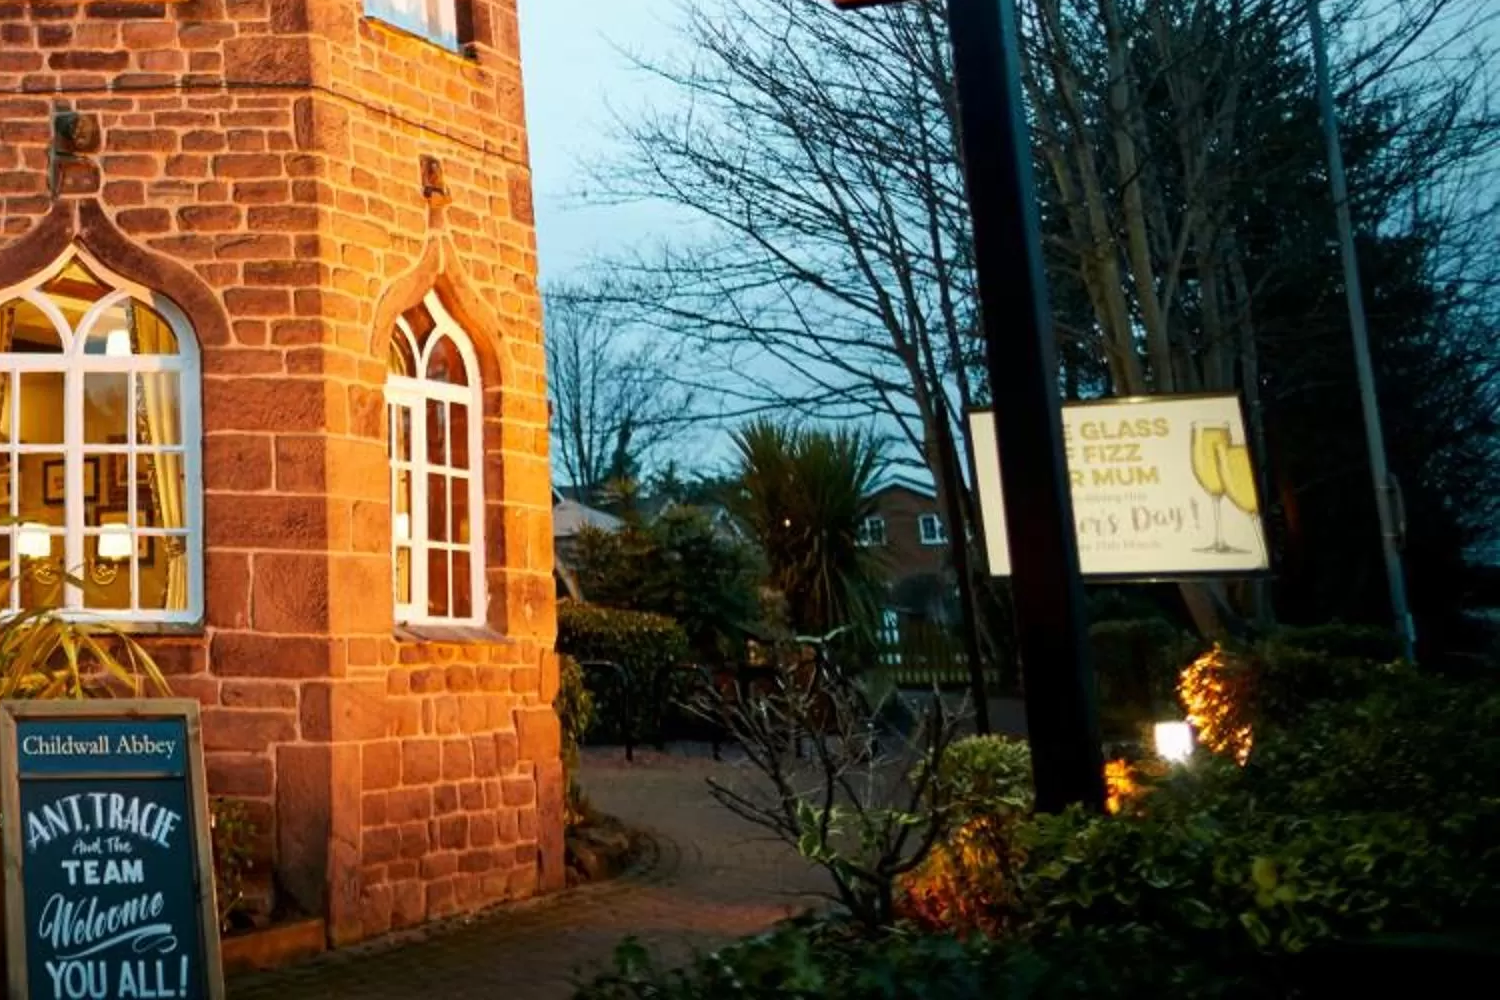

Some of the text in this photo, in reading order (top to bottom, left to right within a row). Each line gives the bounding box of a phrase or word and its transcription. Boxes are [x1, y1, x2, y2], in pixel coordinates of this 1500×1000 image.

[1080, 417, 1170, 440] GLASS
[1083, 443, 1143, 463] FIZZ
[1091, 465, 1160, 486] MUM
[22, 735, 177, 760] Childwall Abbey
[88, 791, 182, 849] TRACIE
[60, 859, 146, 886] TEAM
[38, 891, 165, 950] Welcome
[45, 954, 190, 1000] YOU ALL!
